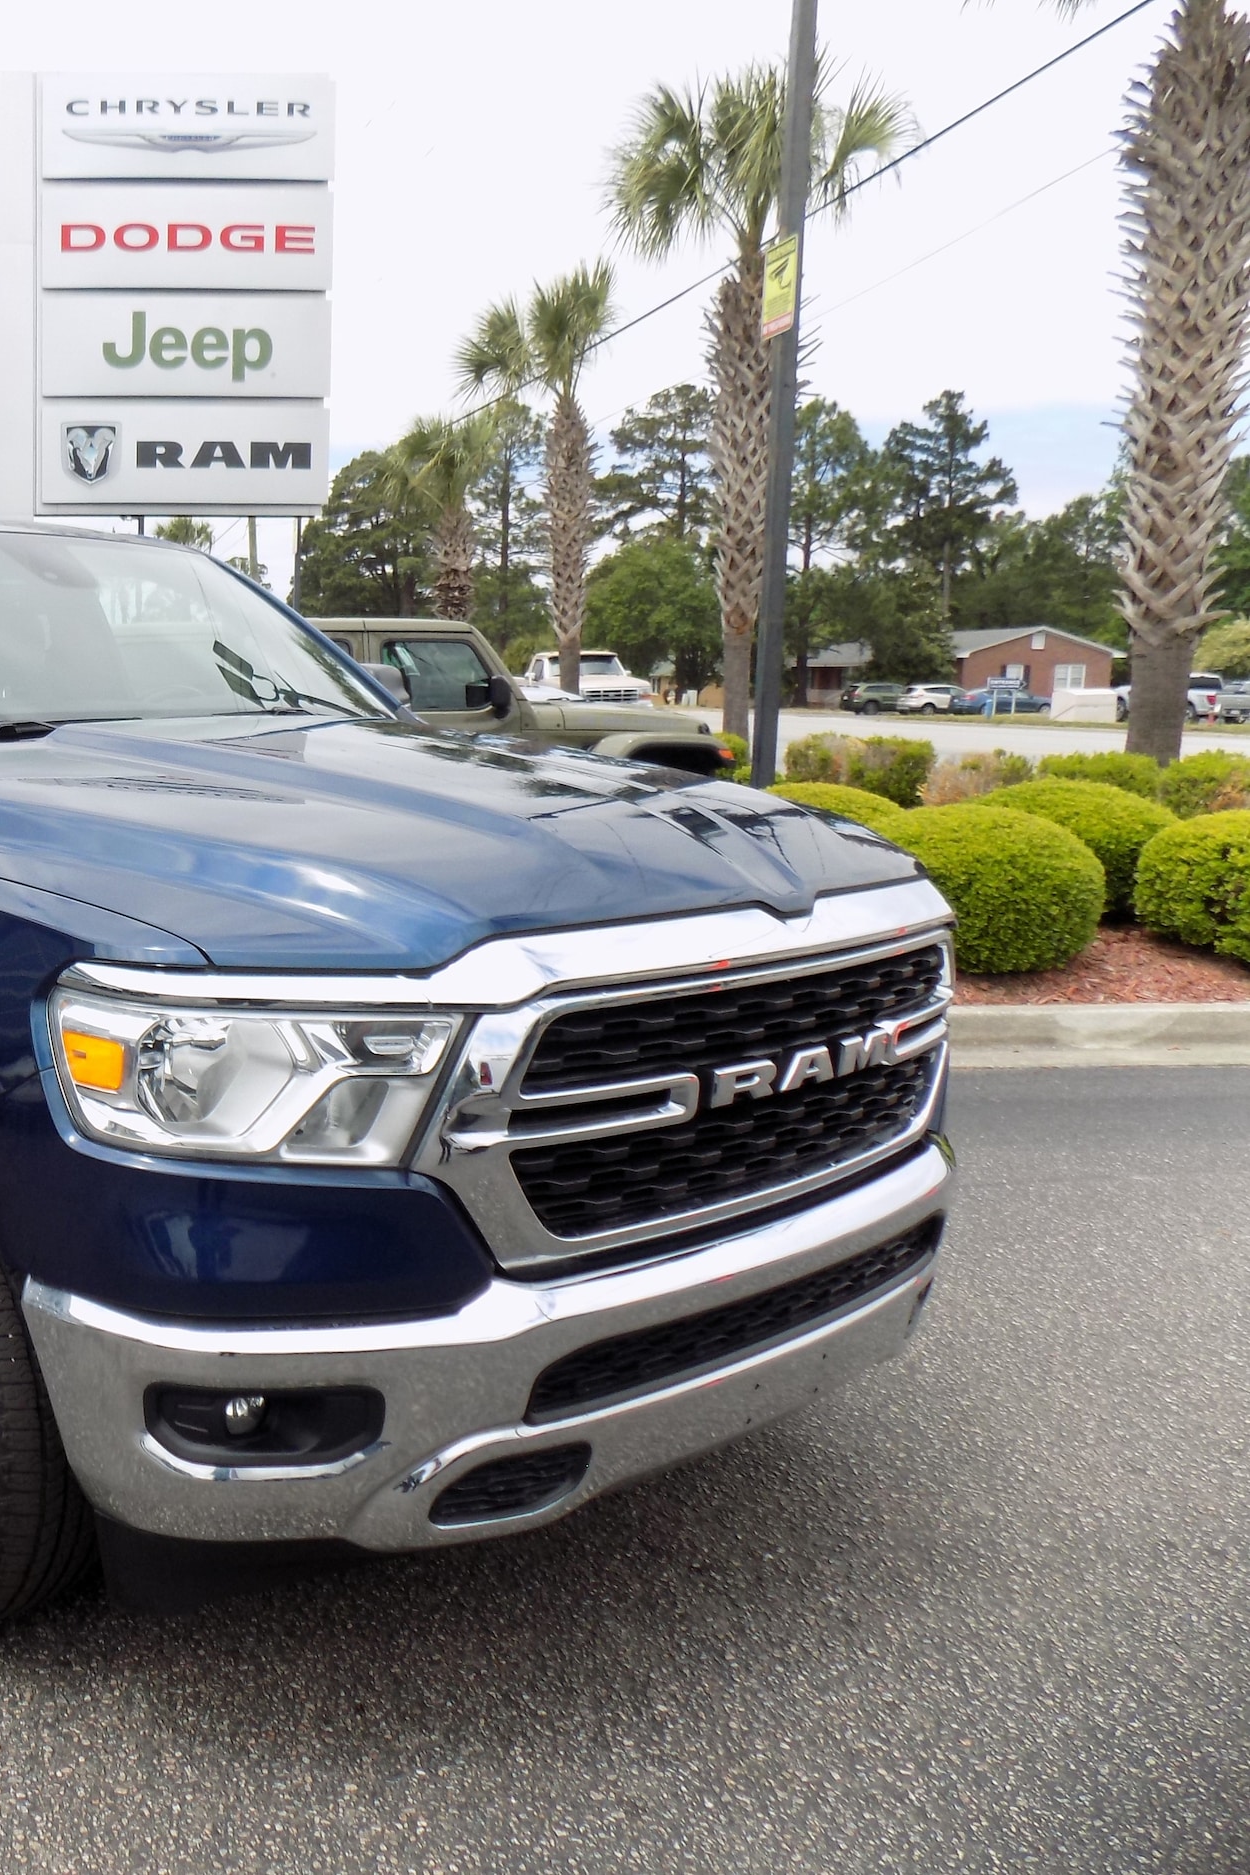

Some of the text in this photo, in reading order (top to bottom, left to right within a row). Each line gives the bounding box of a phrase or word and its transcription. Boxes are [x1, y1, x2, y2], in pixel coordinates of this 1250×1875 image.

[65, 99, 311, 118] CHRYSLER
[60, 223, 316, 254] DODGE
[102, 310, 273, 382] Jeep
[135, 440, 312, 470] RAM
[710, 1027, 891, 1109] RAM
